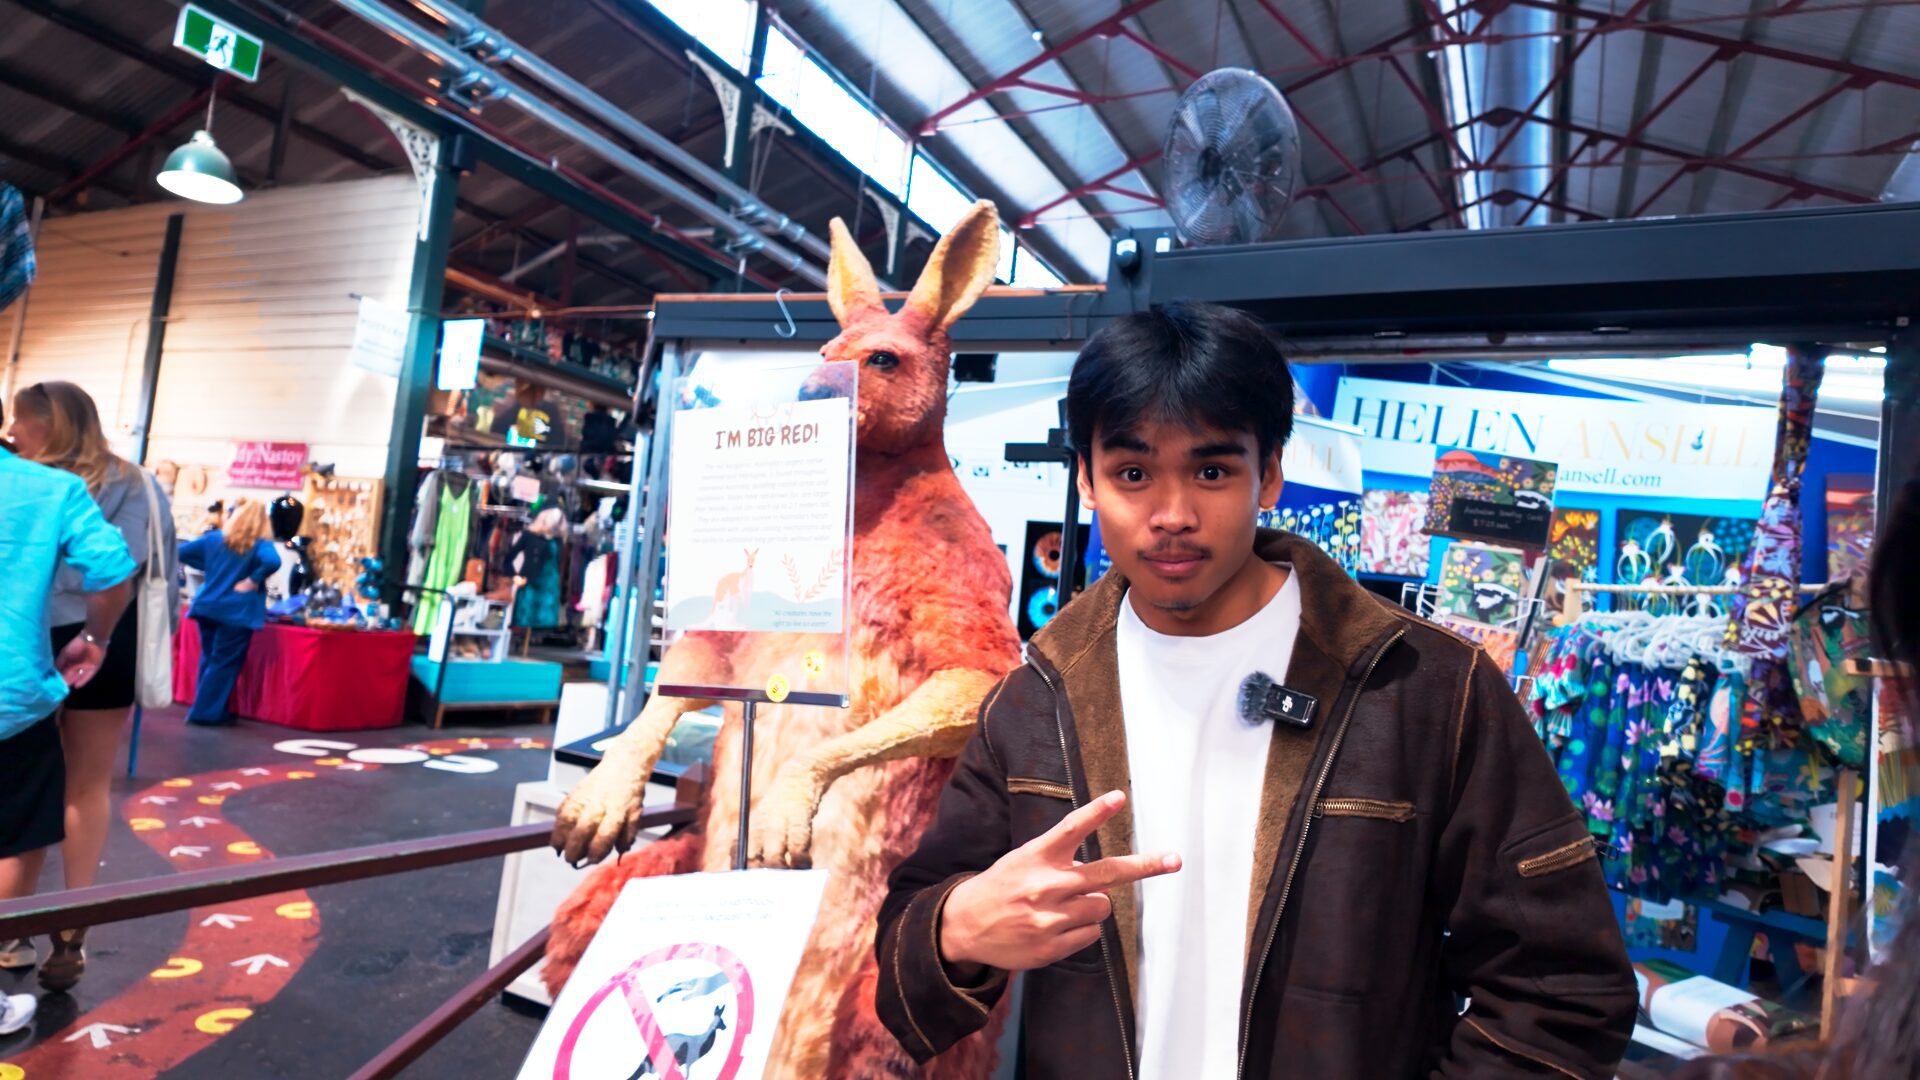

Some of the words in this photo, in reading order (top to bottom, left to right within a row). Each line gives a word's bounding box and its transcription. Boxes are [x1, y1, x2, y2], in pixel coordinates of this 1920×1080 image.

[714, 429, 741, 449] I'M
[747, 426, 776, 447] BIG
[781, 423, 818, 446] RED!
[1353, 396, 1546, 454] HELEN
[1559, 417, 1763, 468] ANSELL
